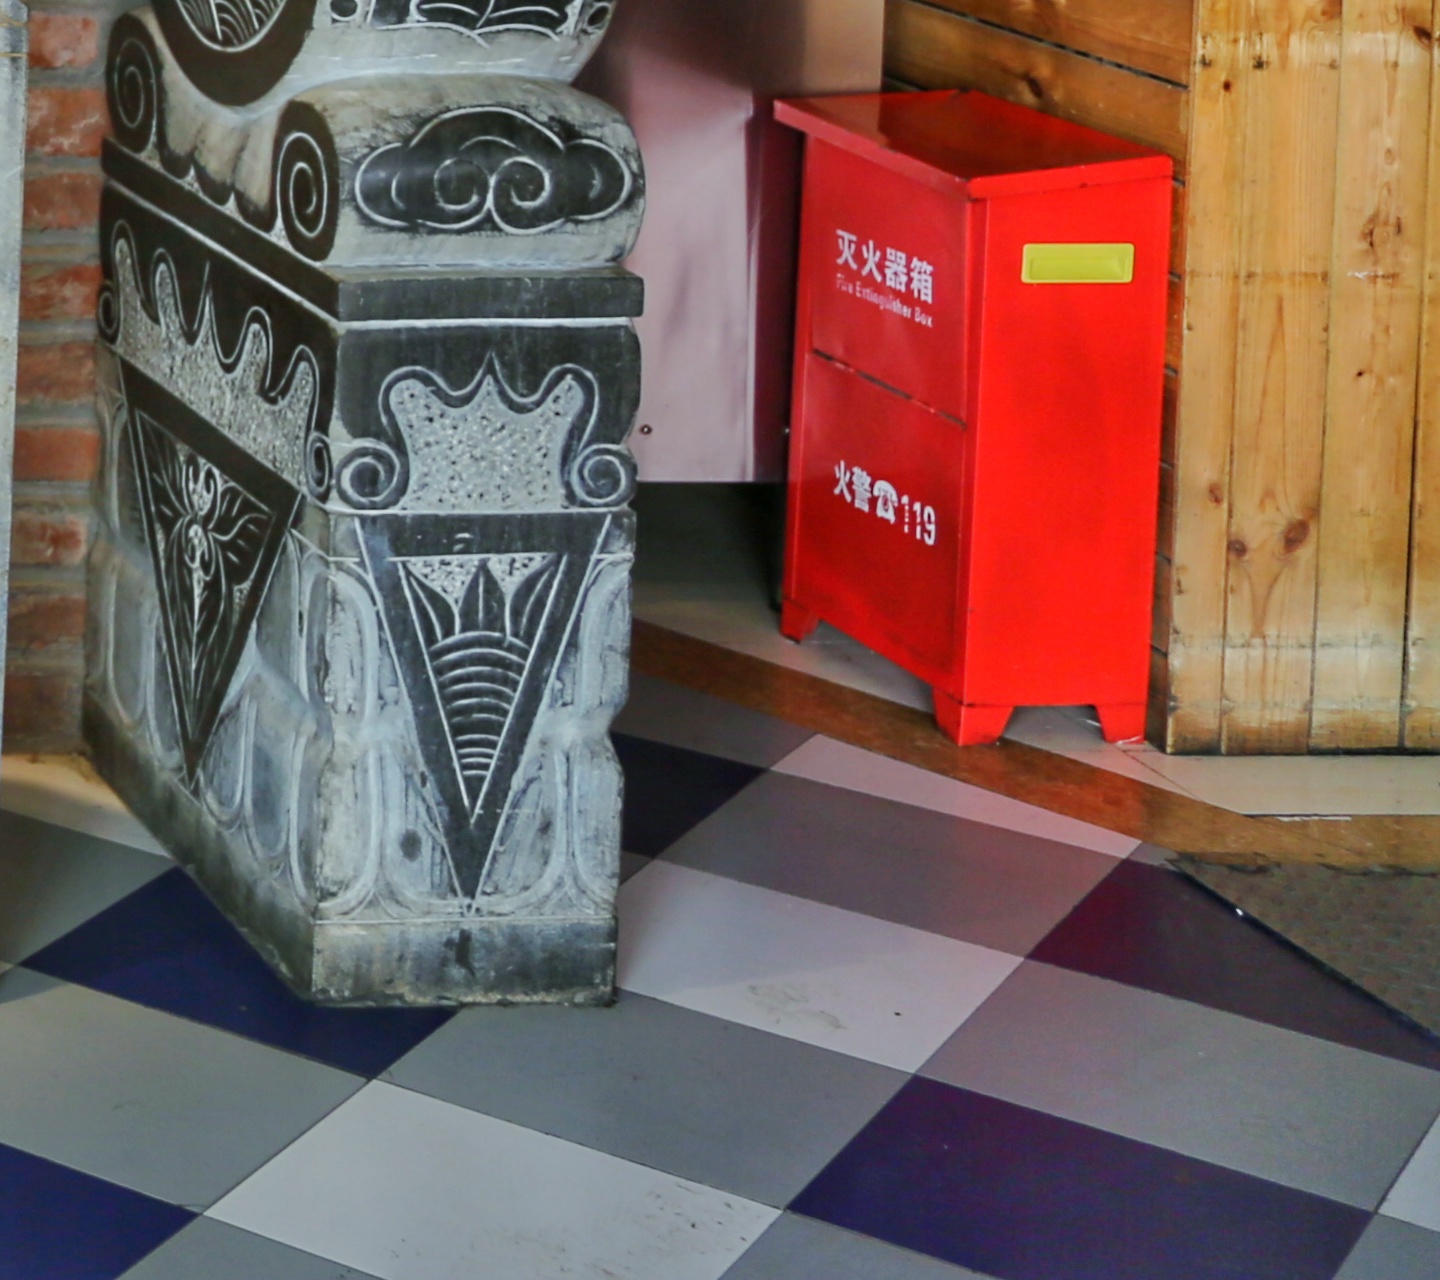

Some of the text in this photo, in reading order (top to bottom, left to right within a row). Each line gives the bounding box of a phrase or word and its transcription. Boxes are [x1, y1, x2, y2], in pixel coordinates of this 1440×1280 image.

[835, 228, 934, 305] 灭火器箱
[914, 306, 933, 328] Box
[833, 459, 936, 545] 火警 119
